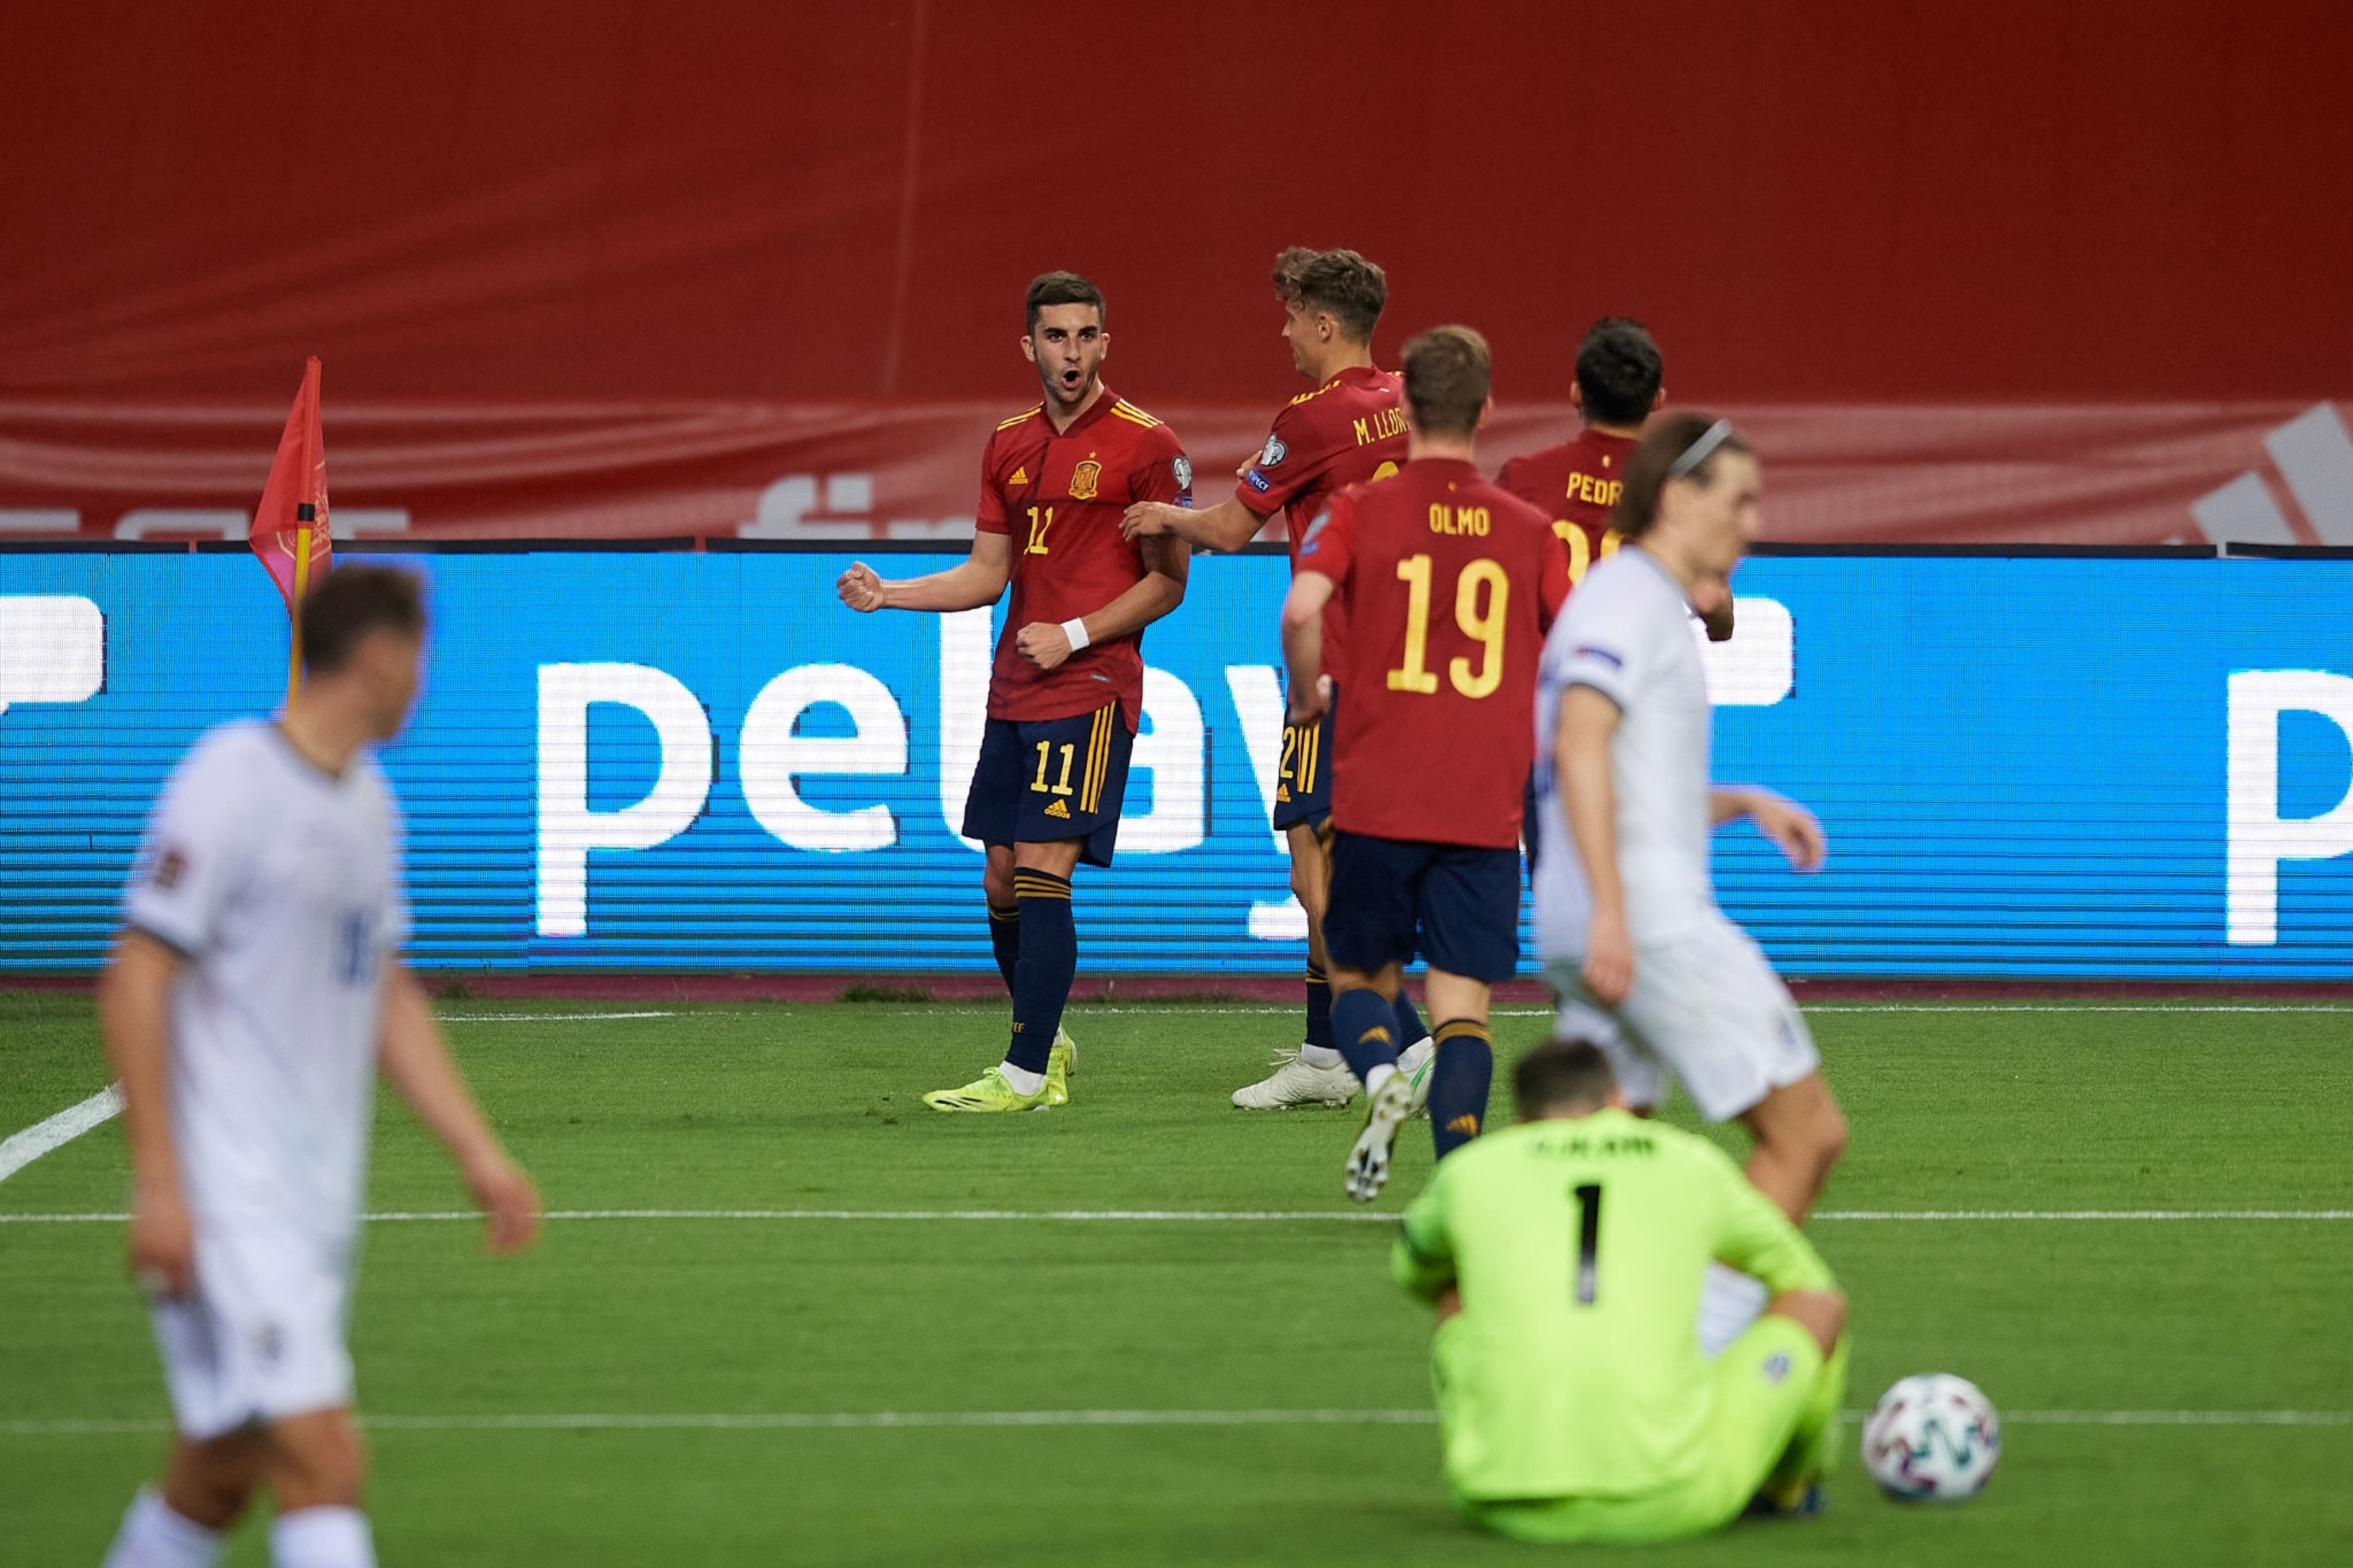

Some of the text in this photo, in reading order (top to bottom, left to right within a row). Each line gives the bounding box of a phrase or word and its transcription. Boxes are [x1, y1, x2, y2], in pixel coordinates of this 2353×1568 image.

[1353, 407, 1411, 446] M. LLOR
[1024, 507, 1053, 555] 11
[1429, 503, 1490, 537] OLMO
[1387, 554, 1509, 698] 19
[1031, 740, 1074, 795] 11
[1044, 808, 1071, 819] adidas
[1573, 1183, 1602, 1306] 1
